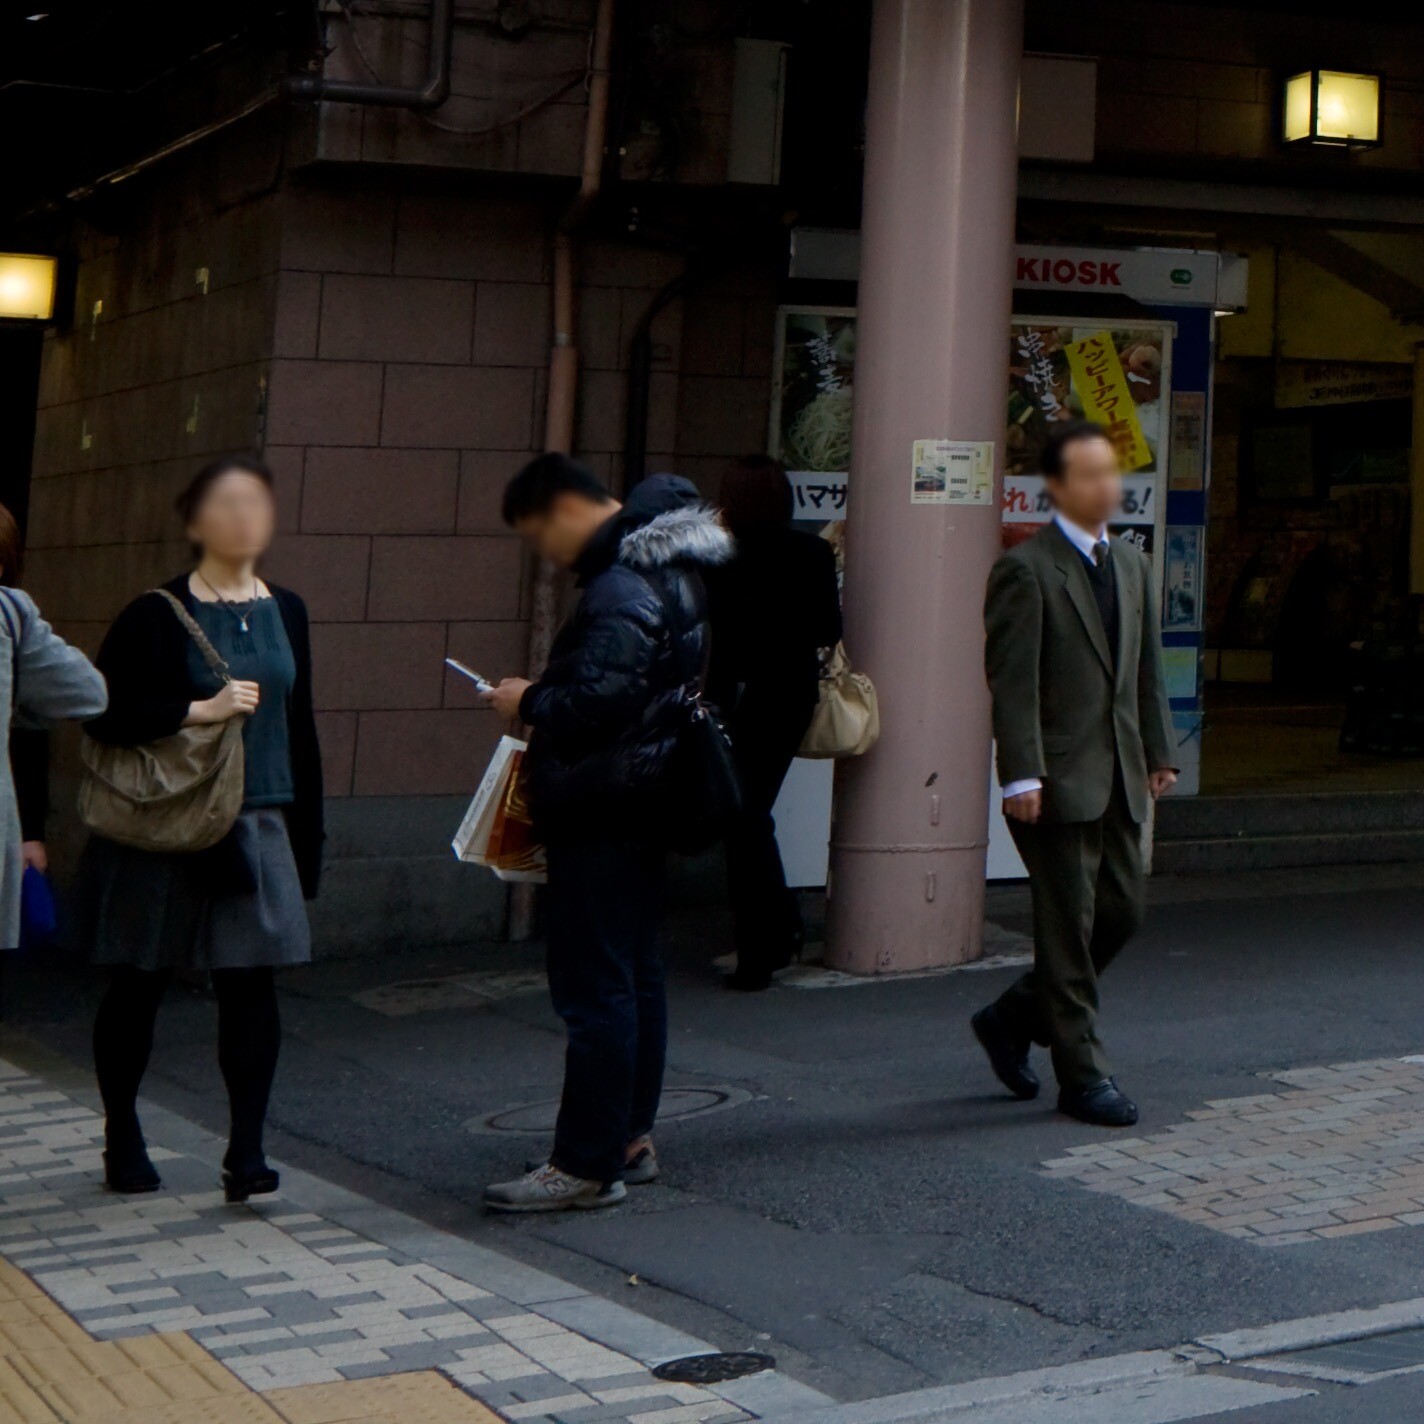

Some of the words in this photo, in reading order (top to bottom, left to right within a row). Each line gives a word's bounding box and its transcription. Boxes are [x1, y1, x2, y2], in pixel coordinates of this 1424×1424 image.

[1016, 257, 1121, 286] KIOSK
[1018, 327, 1062, 422] 串焼き
